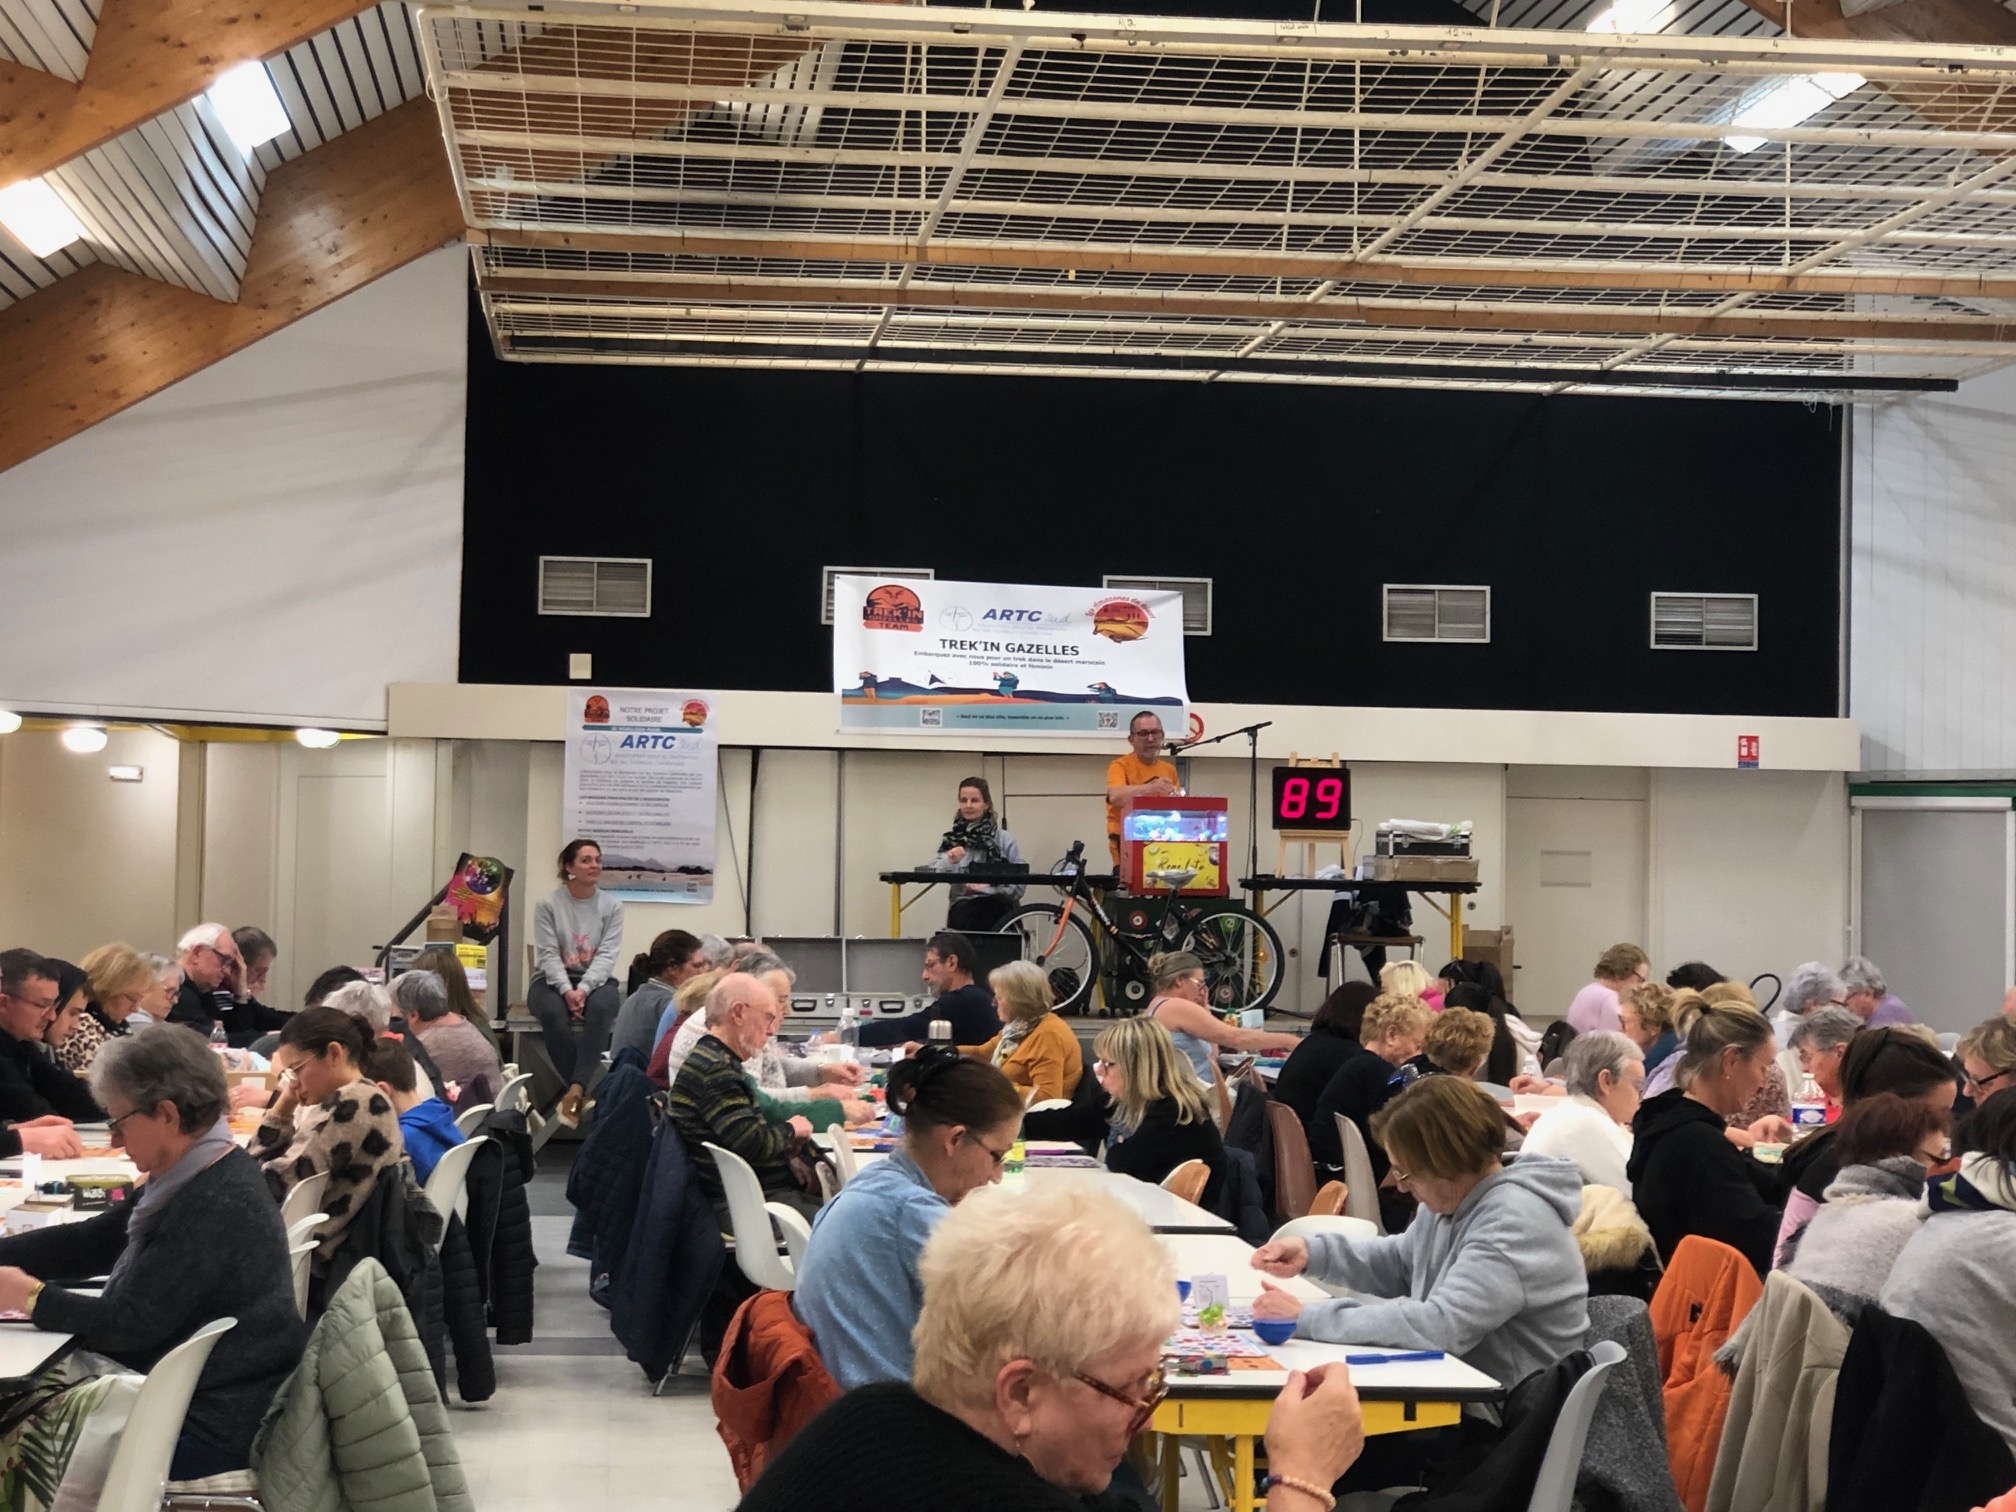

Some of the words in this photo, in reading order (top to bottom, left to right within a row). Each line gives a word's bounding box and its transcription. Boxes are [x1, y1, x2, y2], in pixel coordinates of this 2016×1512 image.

[982, 608, 1043, 622] ARTC
[879, 622, 909, 630] TEAM
[913, 650, 951, 658] Embarquez
[939, 638, 1000, 652] TREK'IN
[1005, 642, 1080, 656] GAZELLES
[619, 706, 642, 714] NOTRE
[644, 707, 669, 715] PROJET
[619, 734, 676, 750] ARTC
[1281, 778, 1343, 819] 89
